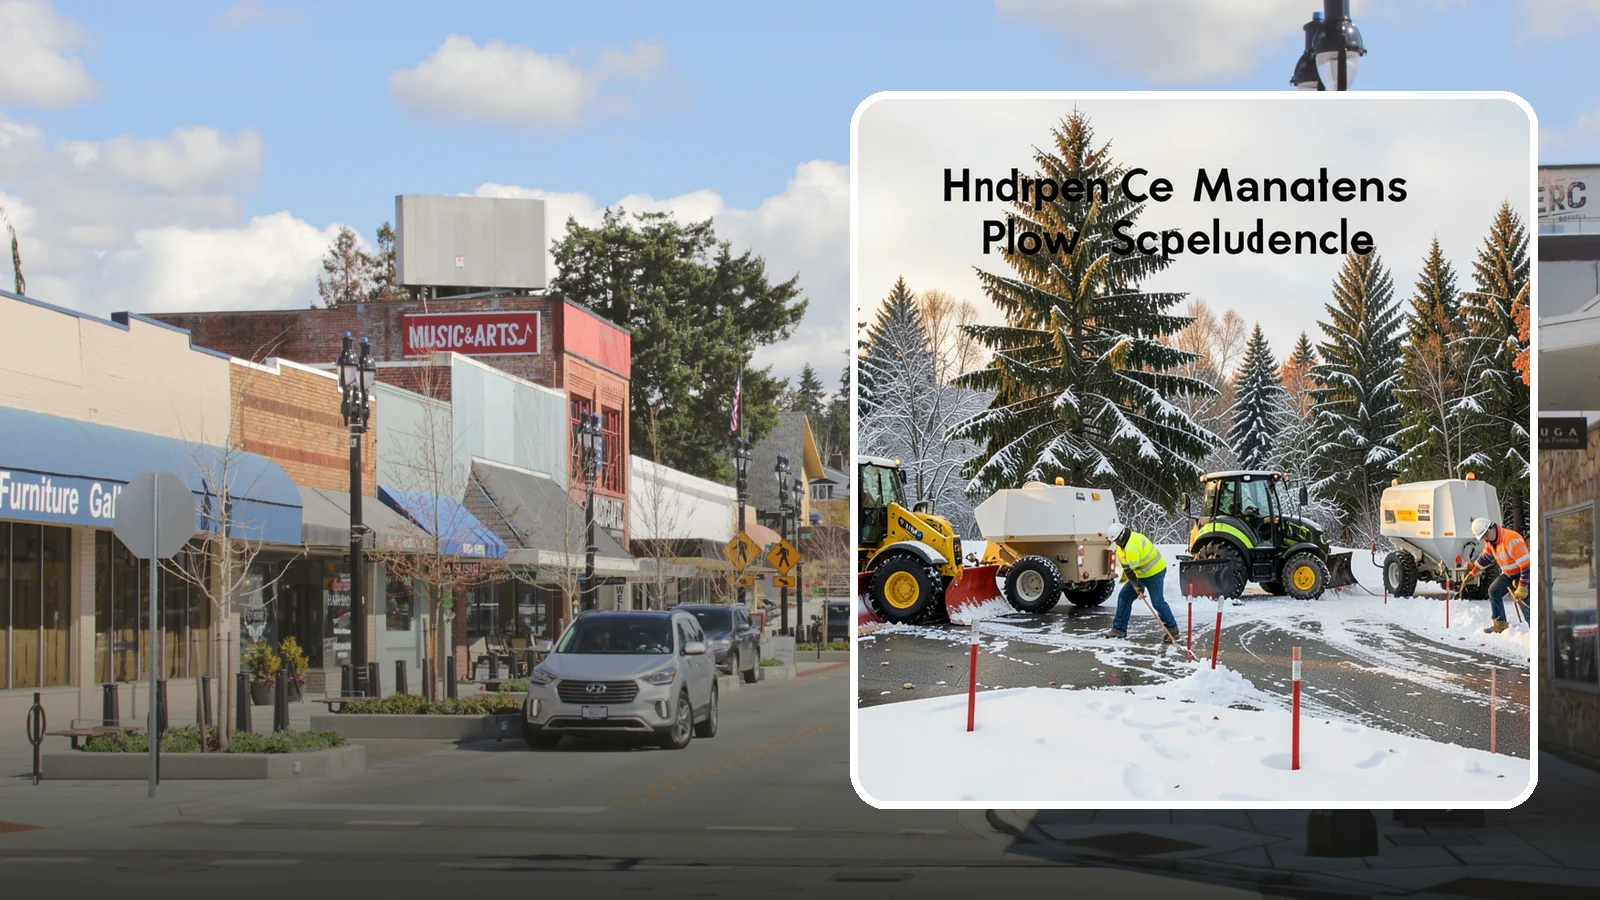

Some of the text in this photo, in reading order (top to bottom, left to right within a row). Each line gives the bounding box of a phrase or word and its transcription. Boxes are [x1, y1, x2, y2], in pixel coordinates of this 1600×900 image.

[409, 323, 520, 349] MUSIC&ARTS
[0, 471, 121, 519] Furniture Gal
